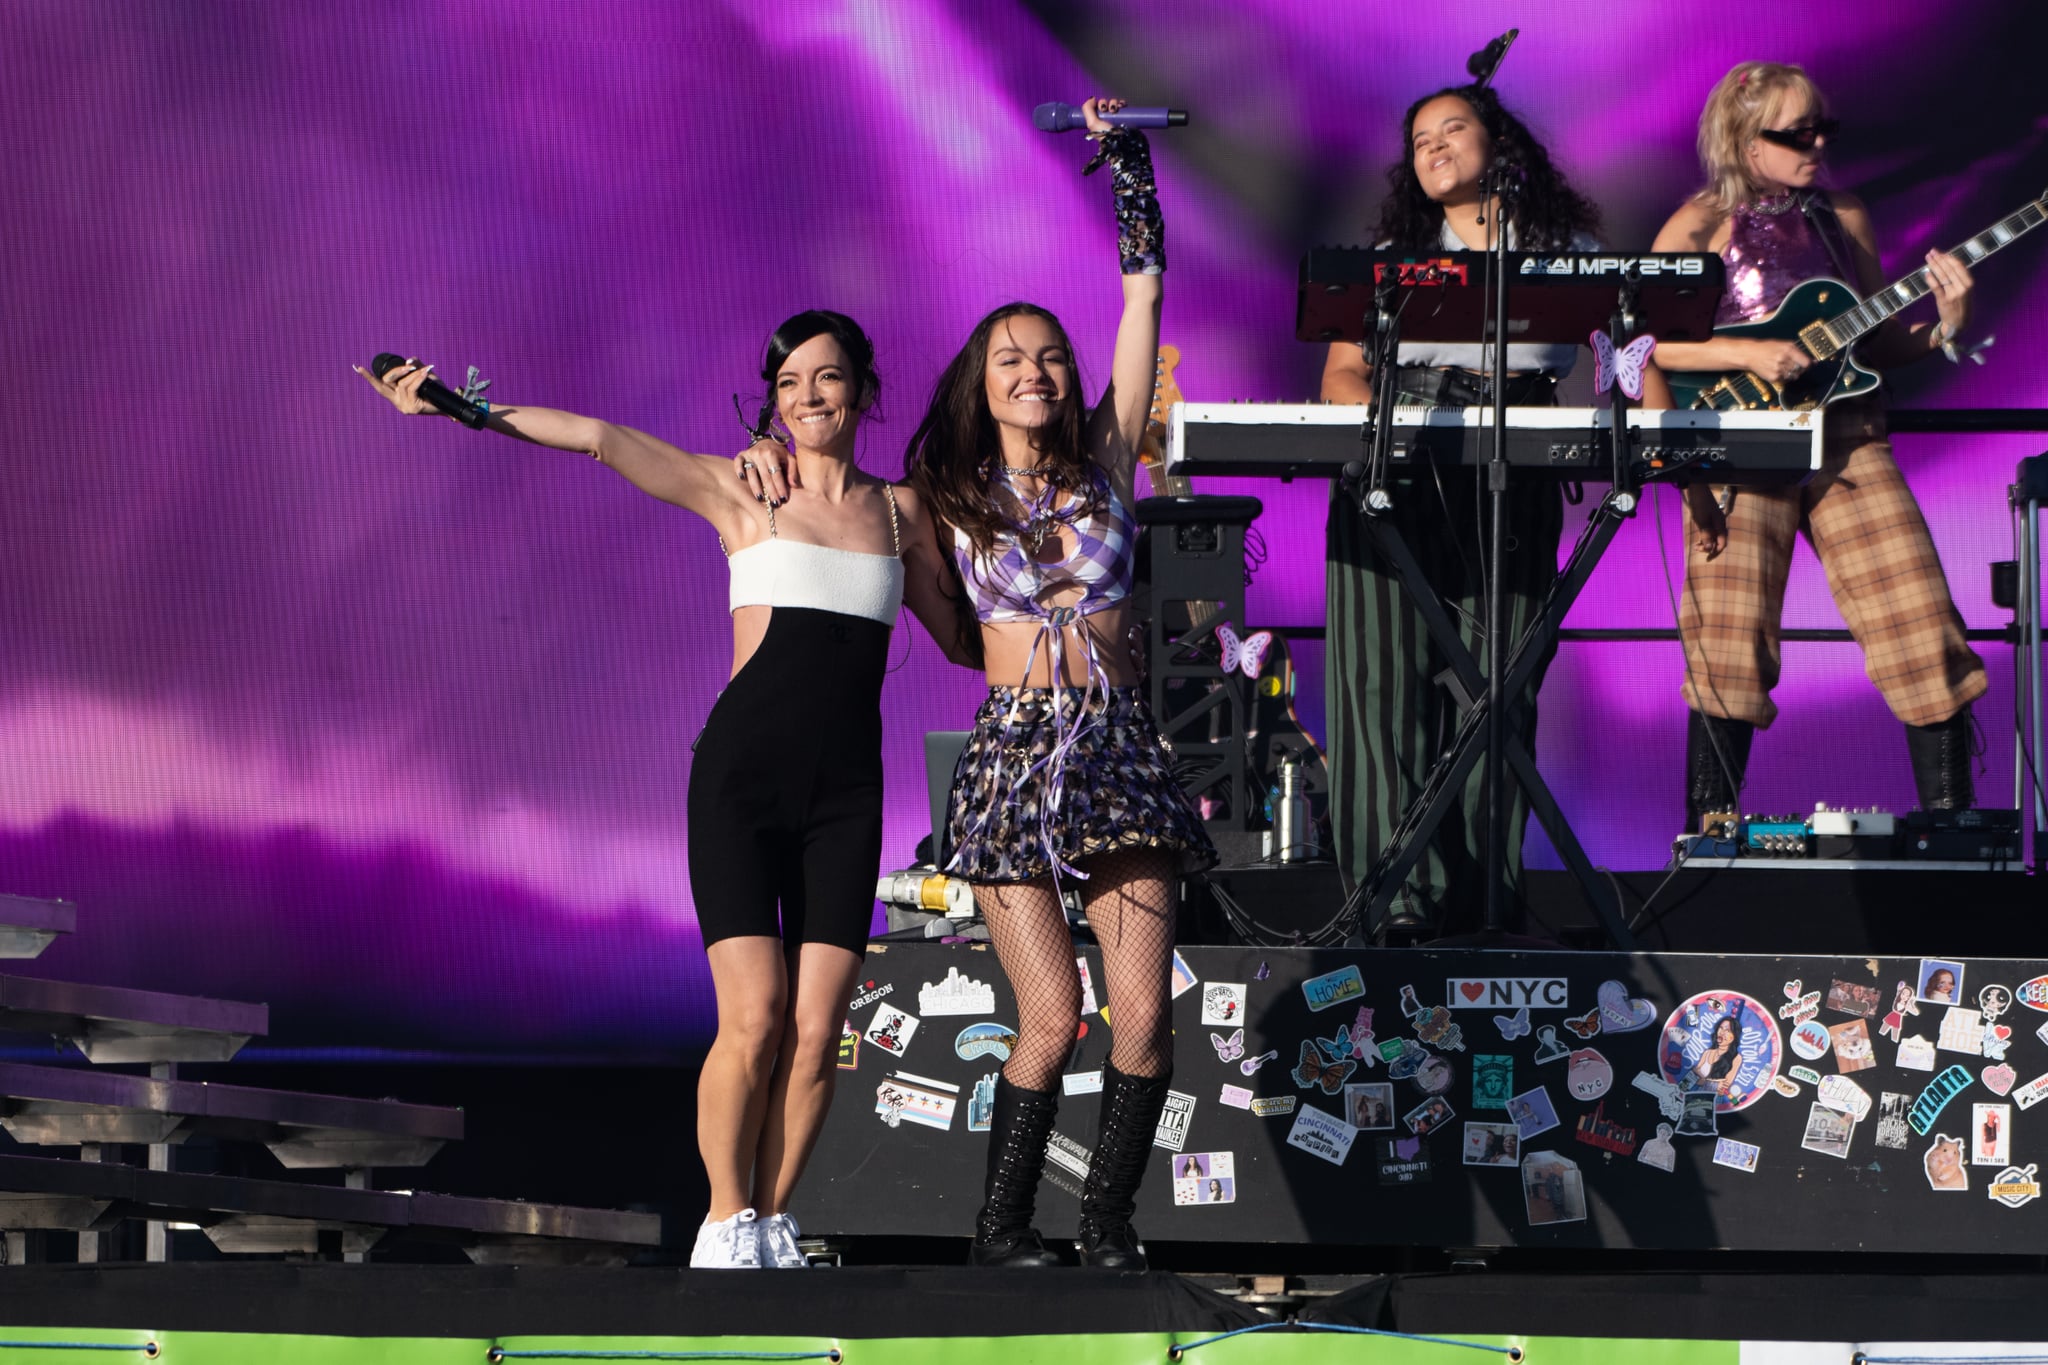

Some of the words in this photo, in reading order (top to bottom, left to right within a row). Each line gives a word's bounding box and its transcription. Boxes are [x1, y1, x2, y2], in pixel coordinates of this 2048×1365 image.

[1519, 258, 1572, 270] AKAI
[1578, 258, 1703, 275] MPK249
[849, 983, 894, 1010] OREGON
[857, 984, 866, 995] I
[1314, 977, 1352, 1003] HOME
[1449, 981, 1455, 1005] I
[1490, 980, 1566, 1005] NYC
[2025, 983, 2048, 1003] KEE
[922, 997, 992, 1009] CHICAGO
[1943, 1011, 1983, 1032] ATL
[1681, 1029, 1712, 1069] SOUR
[1740, 1026, 1762, 1063] BOSTON
[1940, 1029, 1982, 1053] HOE
[1577, 1079, 1602, 1093] NYC
[1164, 1096, 1190, 1113] AIGHT
[1258, 1105, 1291, 1113] sunshine
[1909, 1067, 1969, 1132] ATLANTA
[1163, 1108, 1186, 1131] TTA
[1155, 1126, 1182, 1144] WAUKEE
[1297, 1116, 1351, 1146] CINCINNATI
[1389, 1141, 1394, 1158] I
[1382, 1161, 1427, 1175] CINCINNATI
